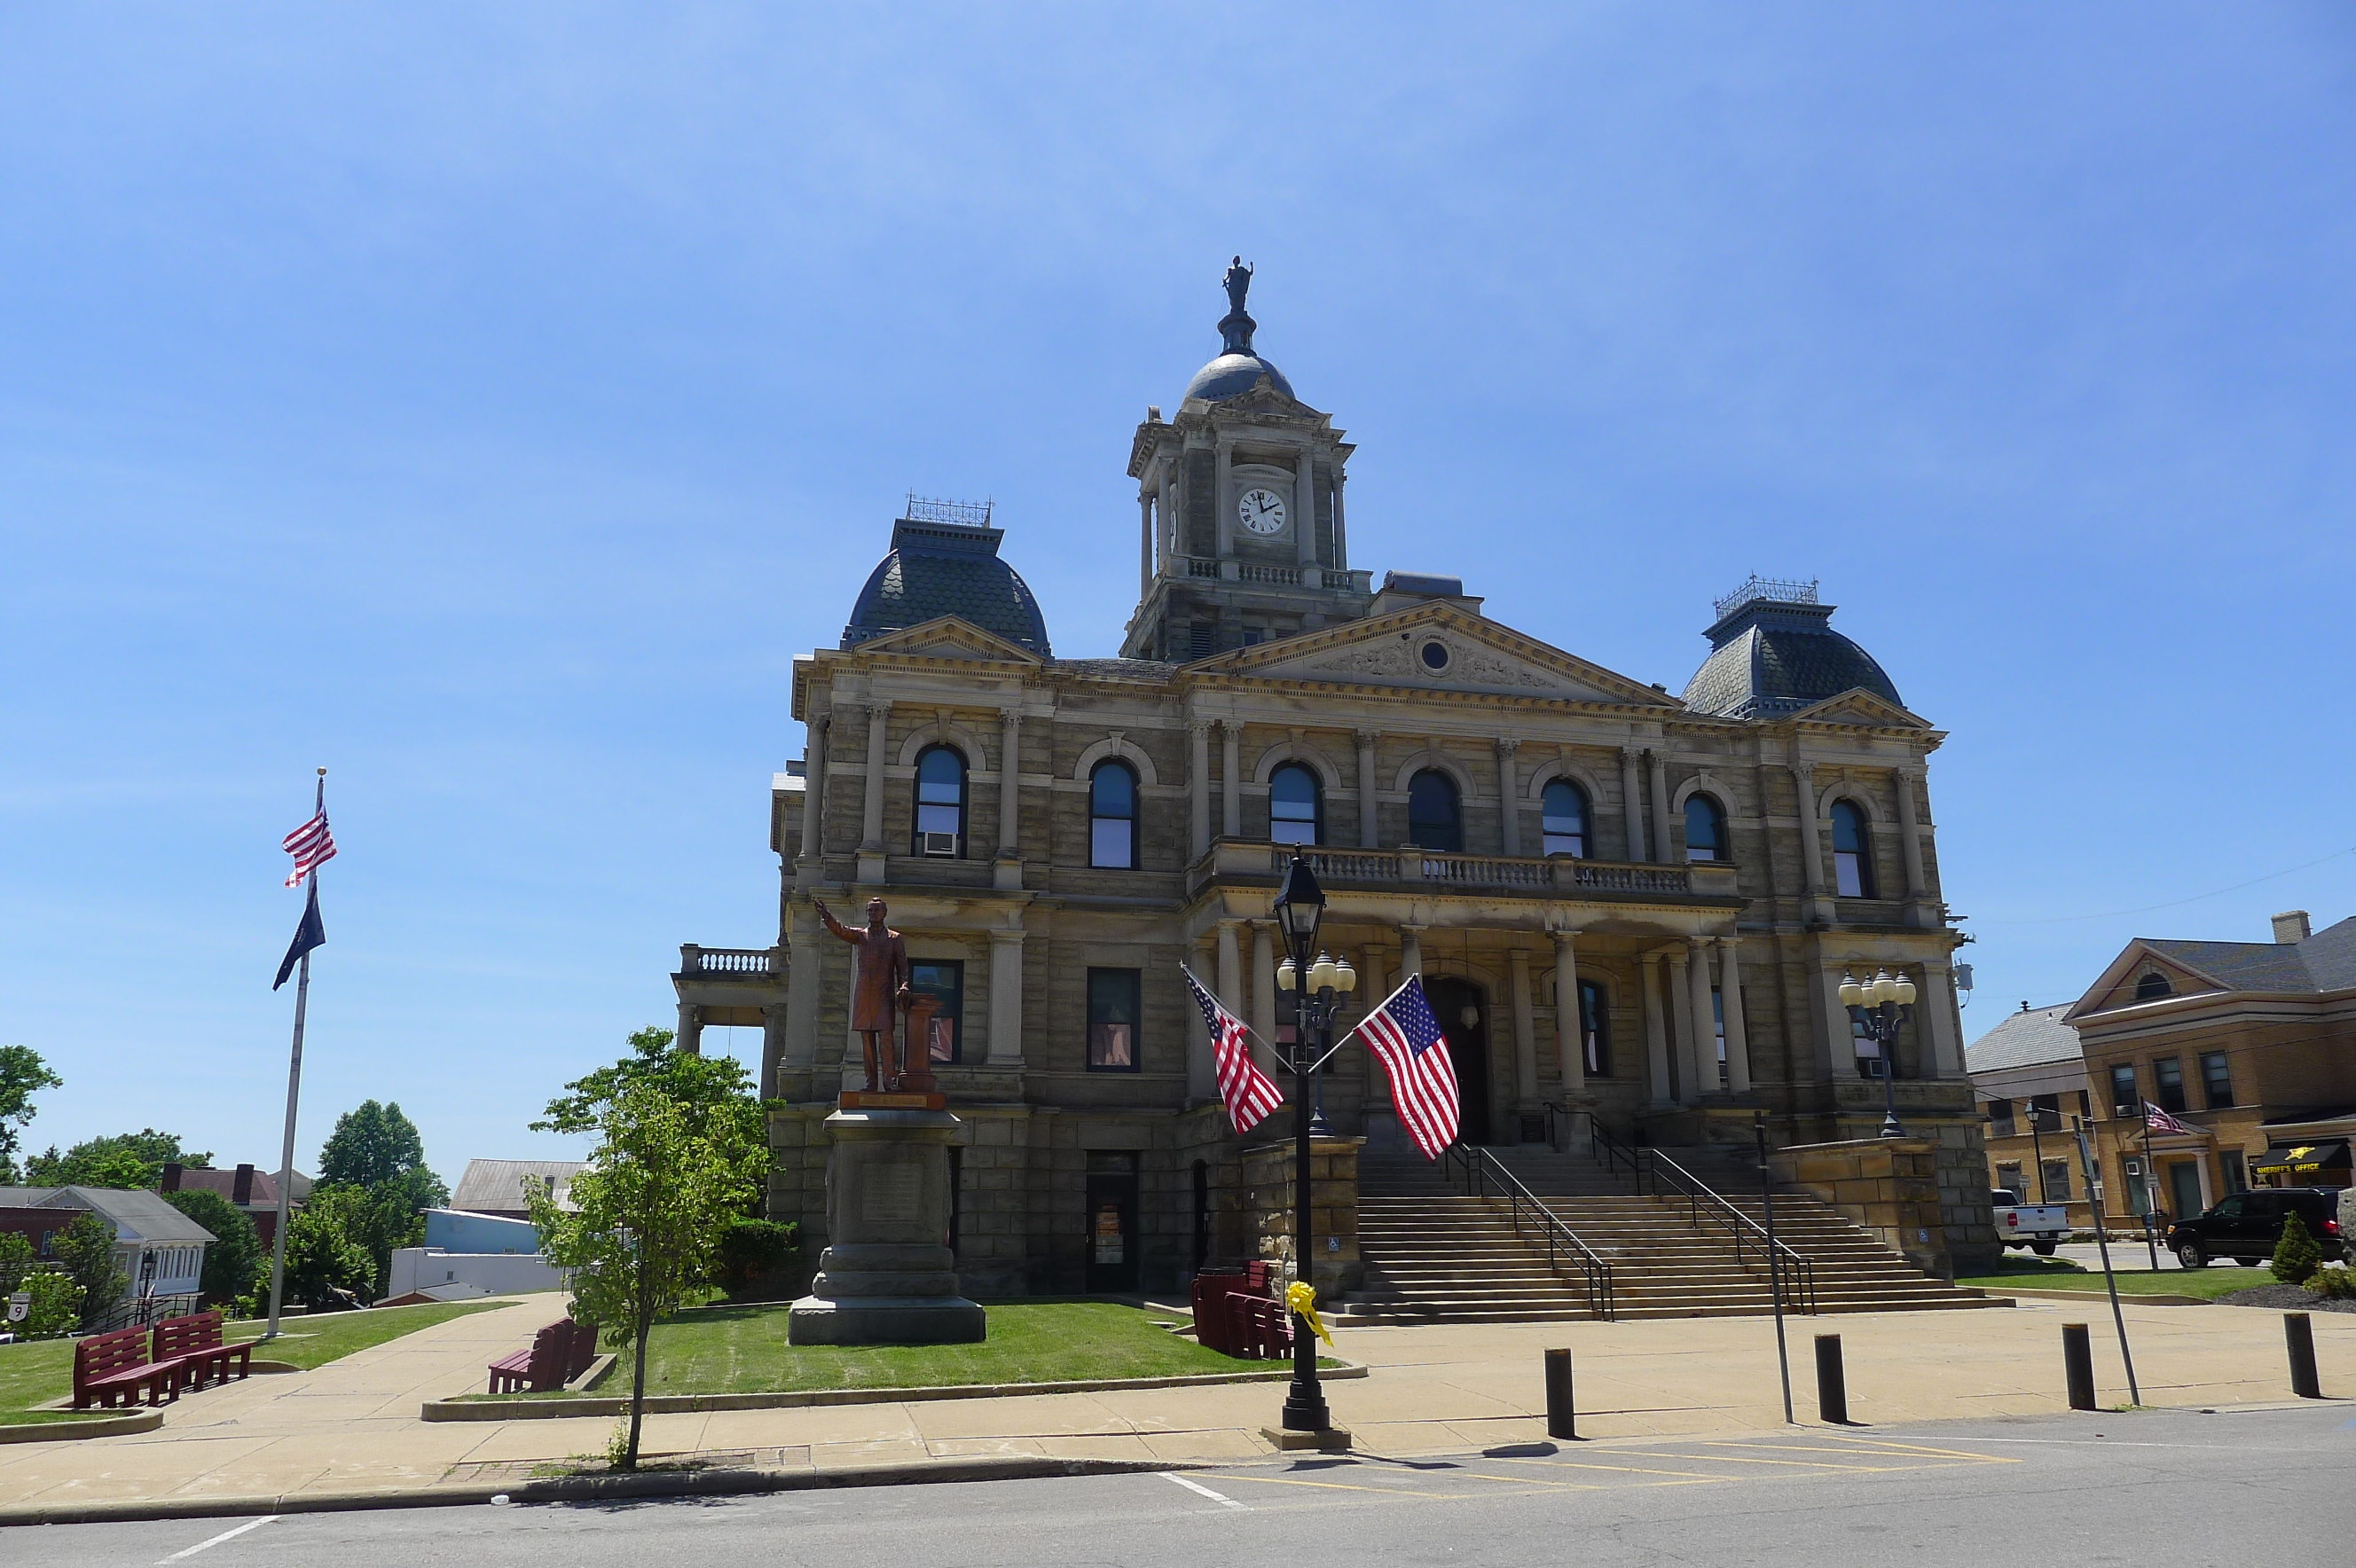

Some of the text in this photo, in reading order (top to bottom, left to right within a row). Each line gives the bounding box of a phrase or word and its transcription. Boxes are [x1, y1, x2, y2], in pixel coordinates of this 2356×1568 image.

[2257, 1163, 2320, 1174] SHERIFF'S OFFICE
[15, 1306, 22, 1317] 9
